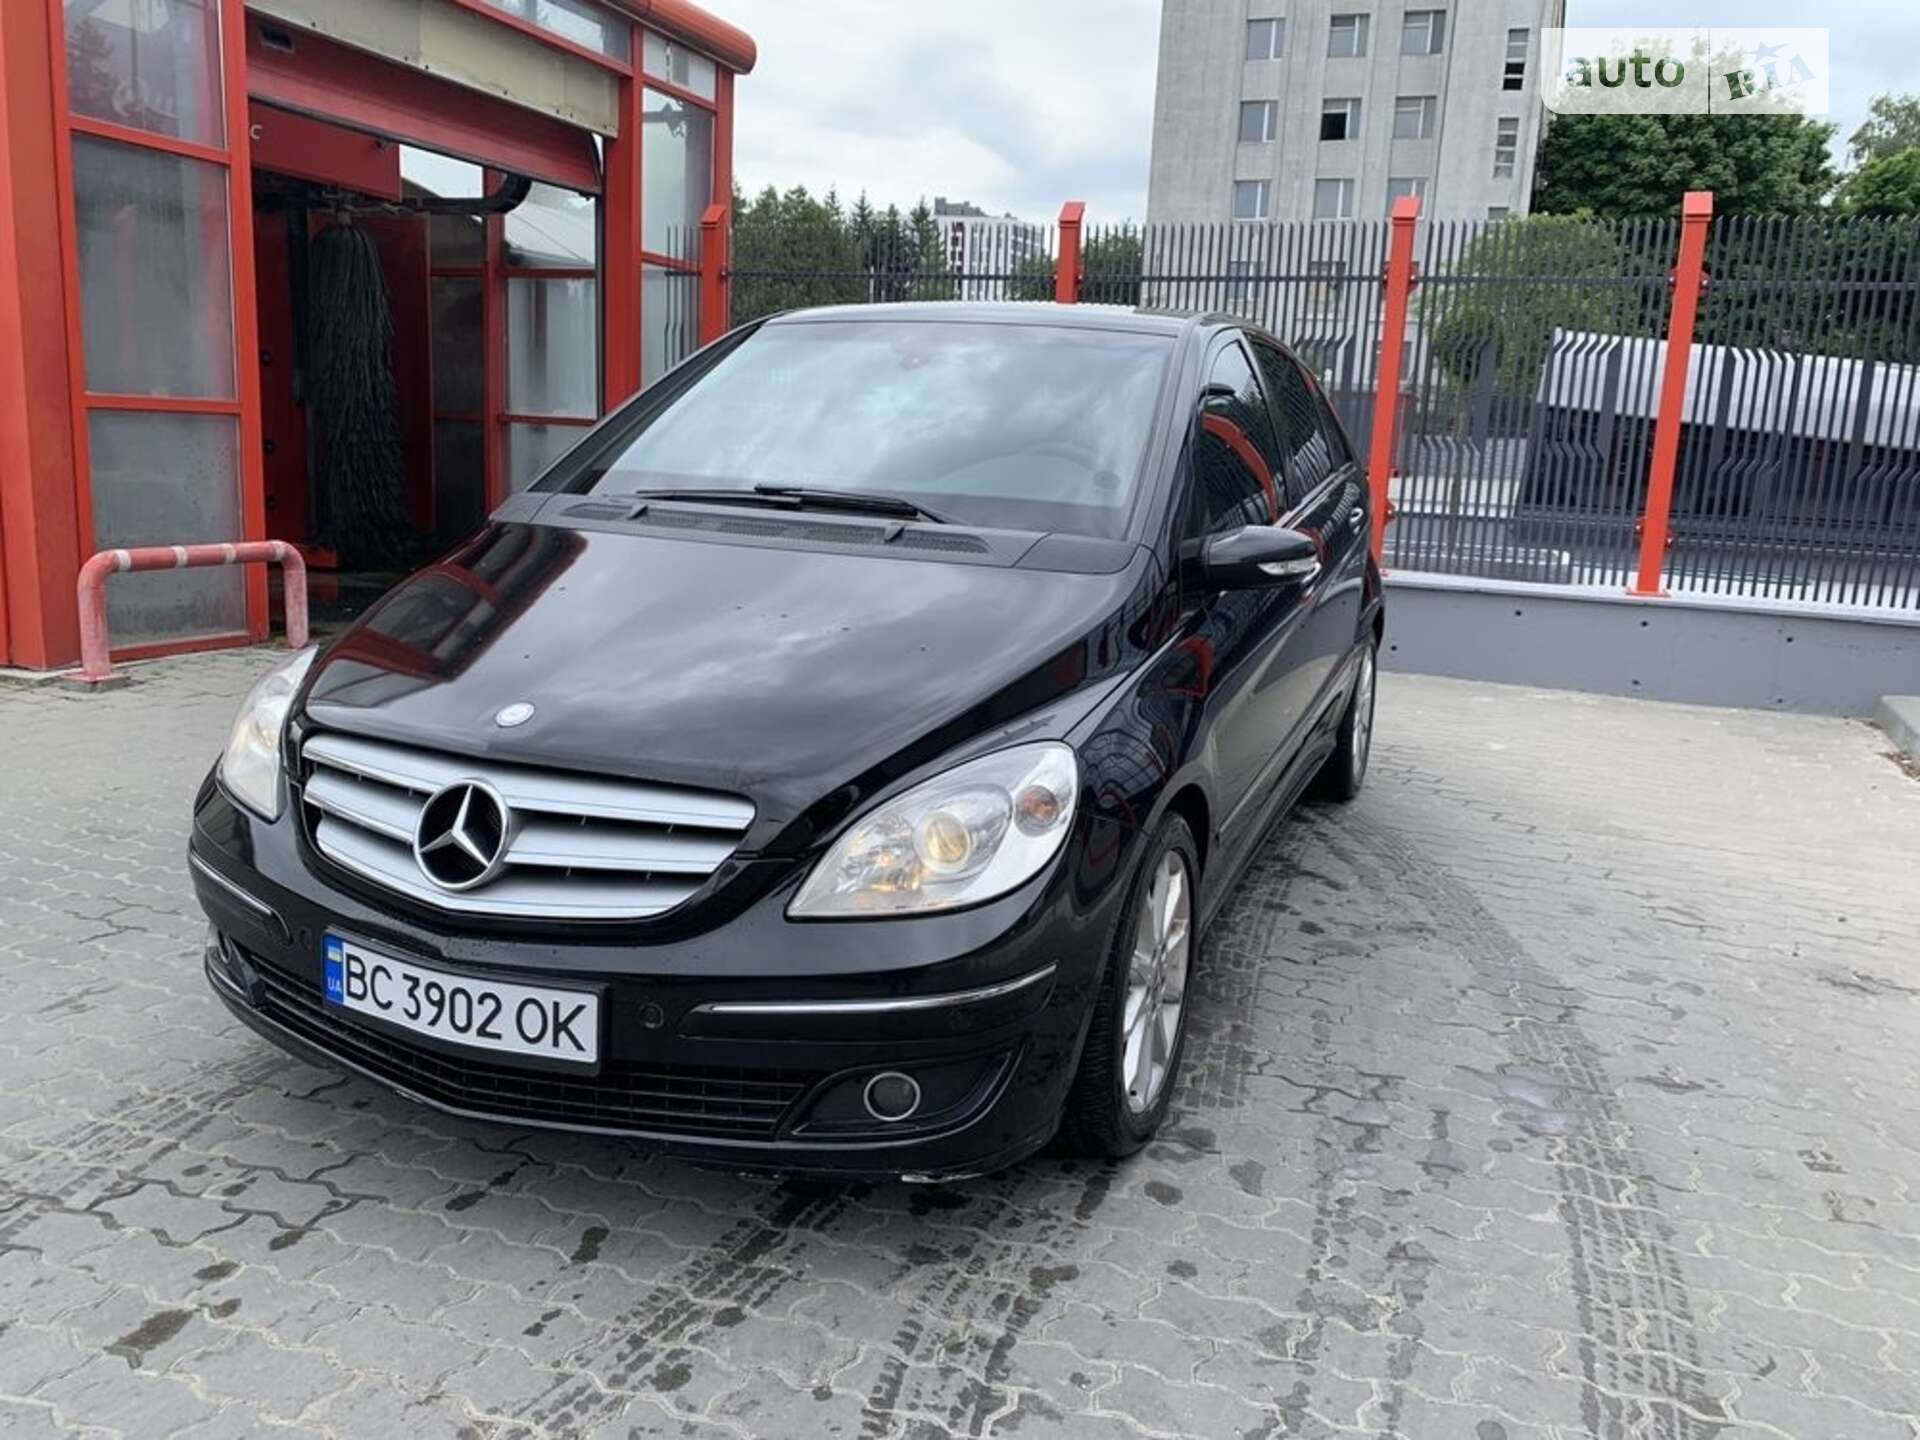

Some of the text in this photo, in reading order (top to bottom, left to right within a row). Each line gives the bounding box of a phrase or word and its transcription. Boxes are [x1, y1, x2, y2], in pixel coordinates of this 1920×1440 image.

[328, 976, 342, 994] UA
[345, 952, 587, 1051] BC 3902 OK
